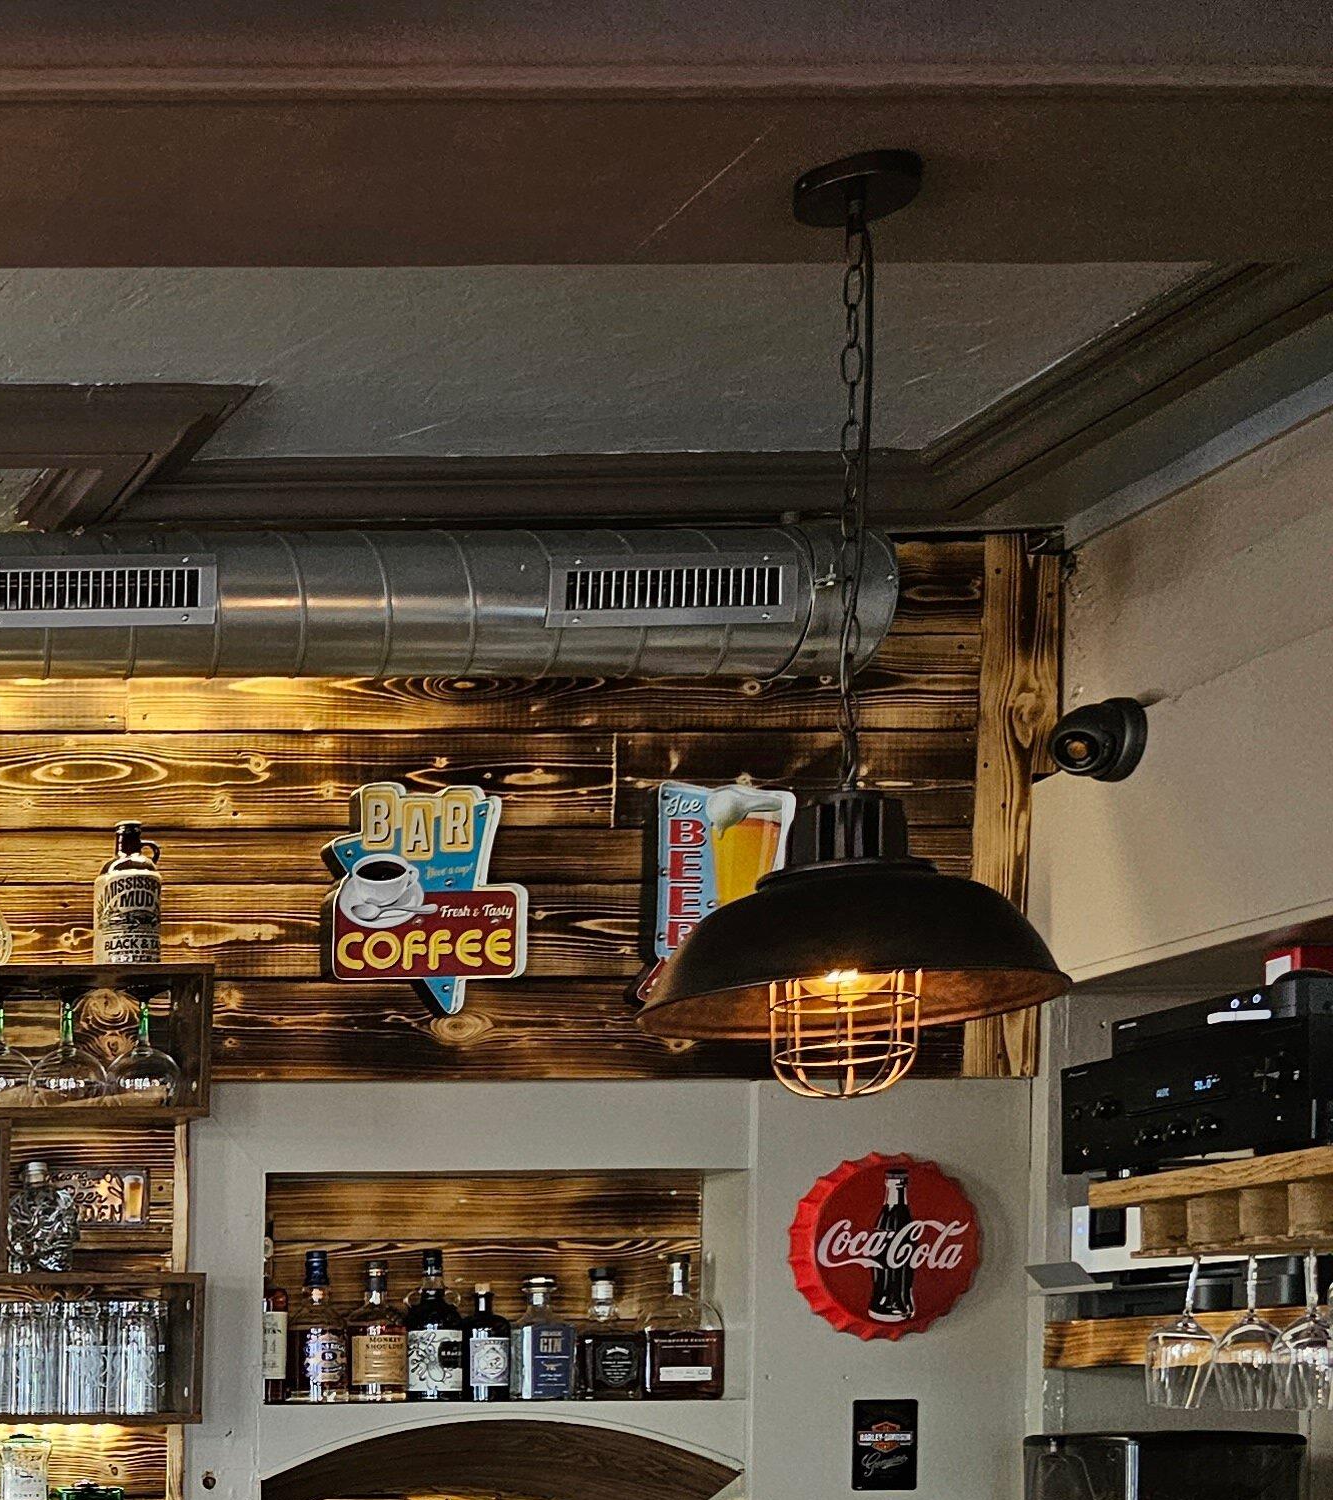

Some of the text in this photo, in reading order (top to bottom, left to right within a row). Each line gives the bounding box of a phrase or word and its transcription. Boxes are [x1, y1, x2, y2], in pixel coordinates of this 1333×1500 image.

[664, 796, 703, 816] Ice
[367, 799, 469, 853] BAR
[120, 890, 154, 907] MUD
[665, 818, 706, 949] BEER
[440, 904, 513, 919] Fresh & Tasty
[104, 939, 139, 951] BLACK
[141, 939, 149, 950] &
[337, 929, 512, 971] COFFEE
[817, 1219, 969, 1270] Coca-Cola
